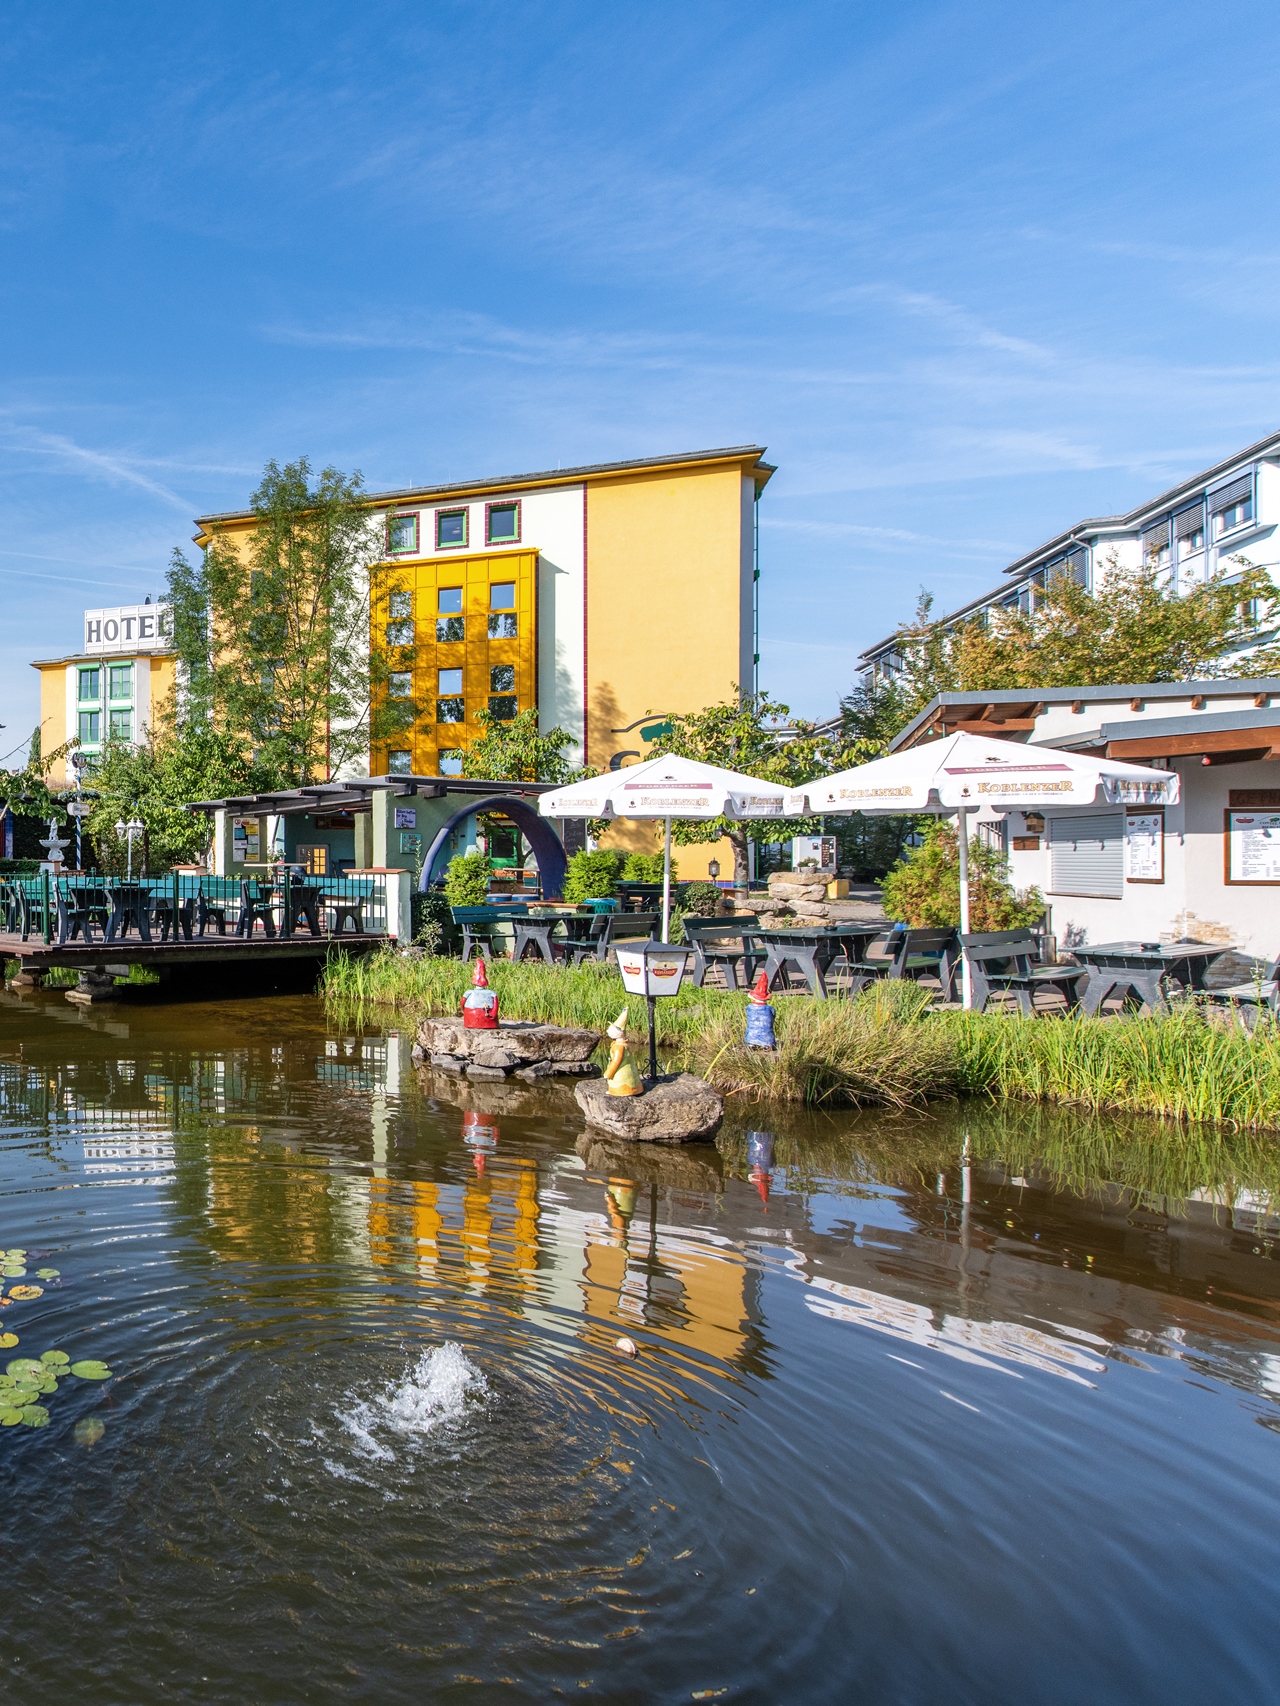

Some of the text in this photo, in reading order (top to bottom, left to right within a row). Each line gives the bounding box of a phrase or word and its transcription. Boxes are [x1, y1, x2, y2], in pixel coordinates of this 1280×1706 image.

[86, 614, 173, 643] HOTEL
[839, 786, 913, 799] KOBLENZER
[977, 780, 1074, 793] KOBLENZER
[640, 797, 709, 807] KOBLENZER
